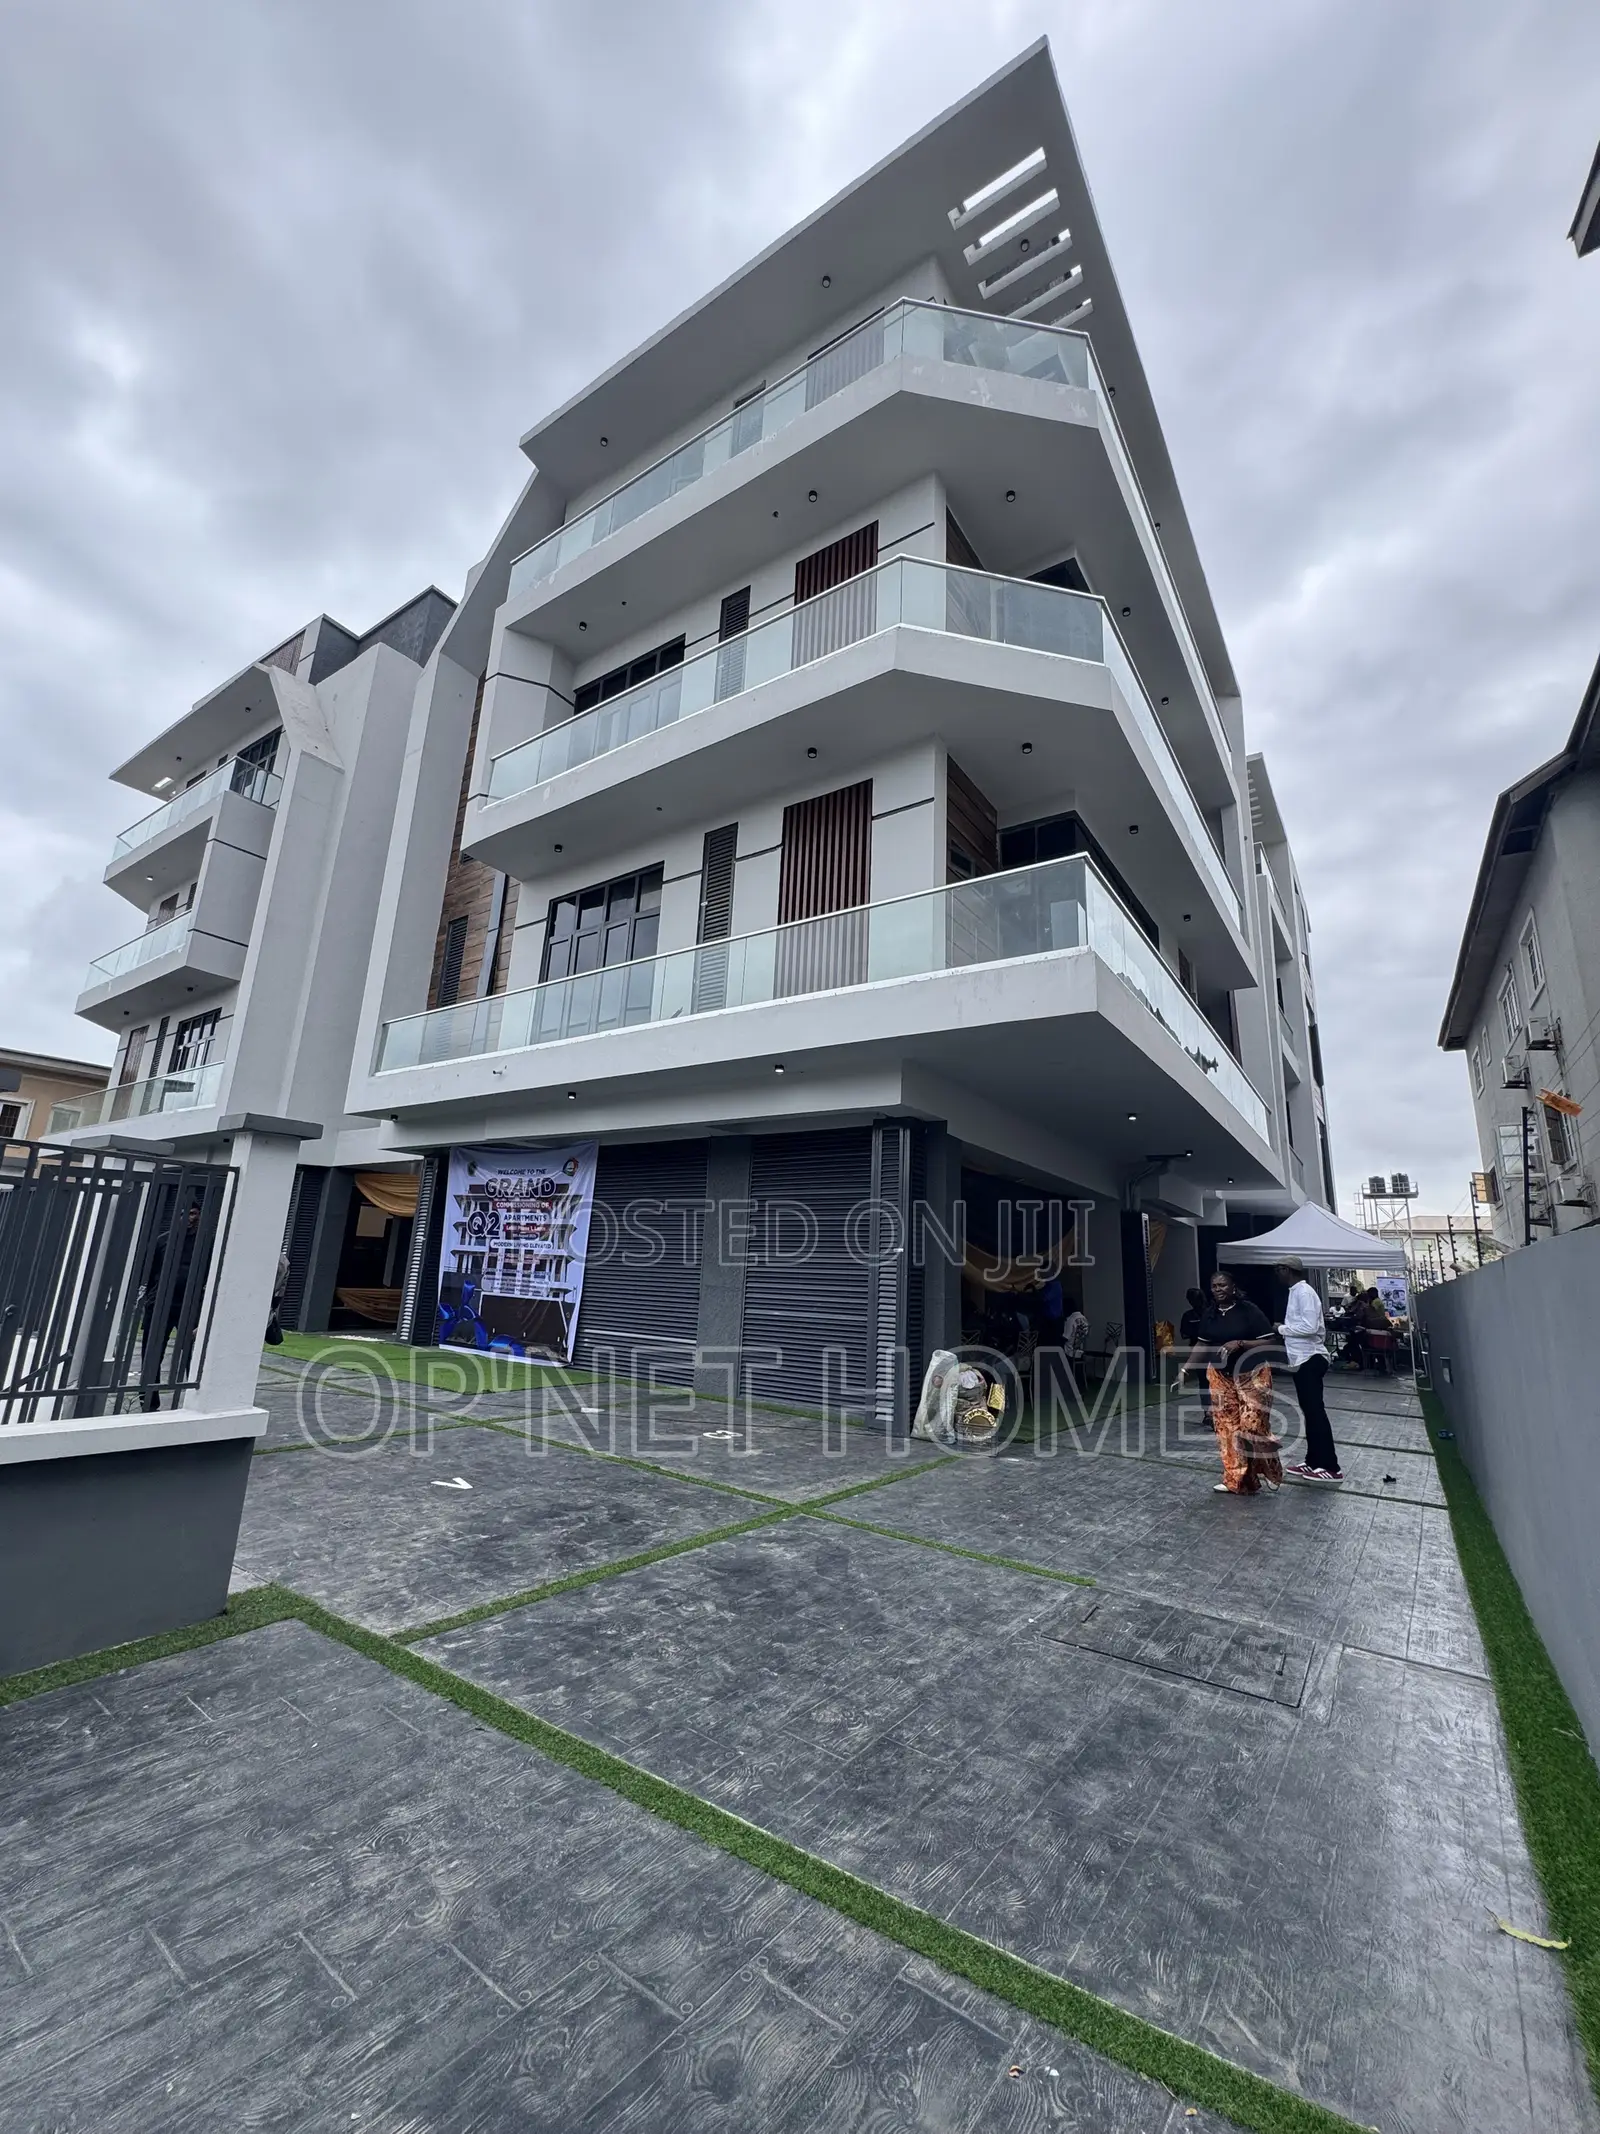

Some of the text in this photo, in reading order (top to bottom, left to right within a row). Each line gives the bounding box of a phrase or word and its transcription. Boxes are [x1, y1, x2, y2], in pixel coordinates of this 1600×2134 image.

[485, 1177, 556, 1198] GRAND
[467, 1210, 500, 1237] Q2
[503, 1214, 547, 1222] APARTMENTS
